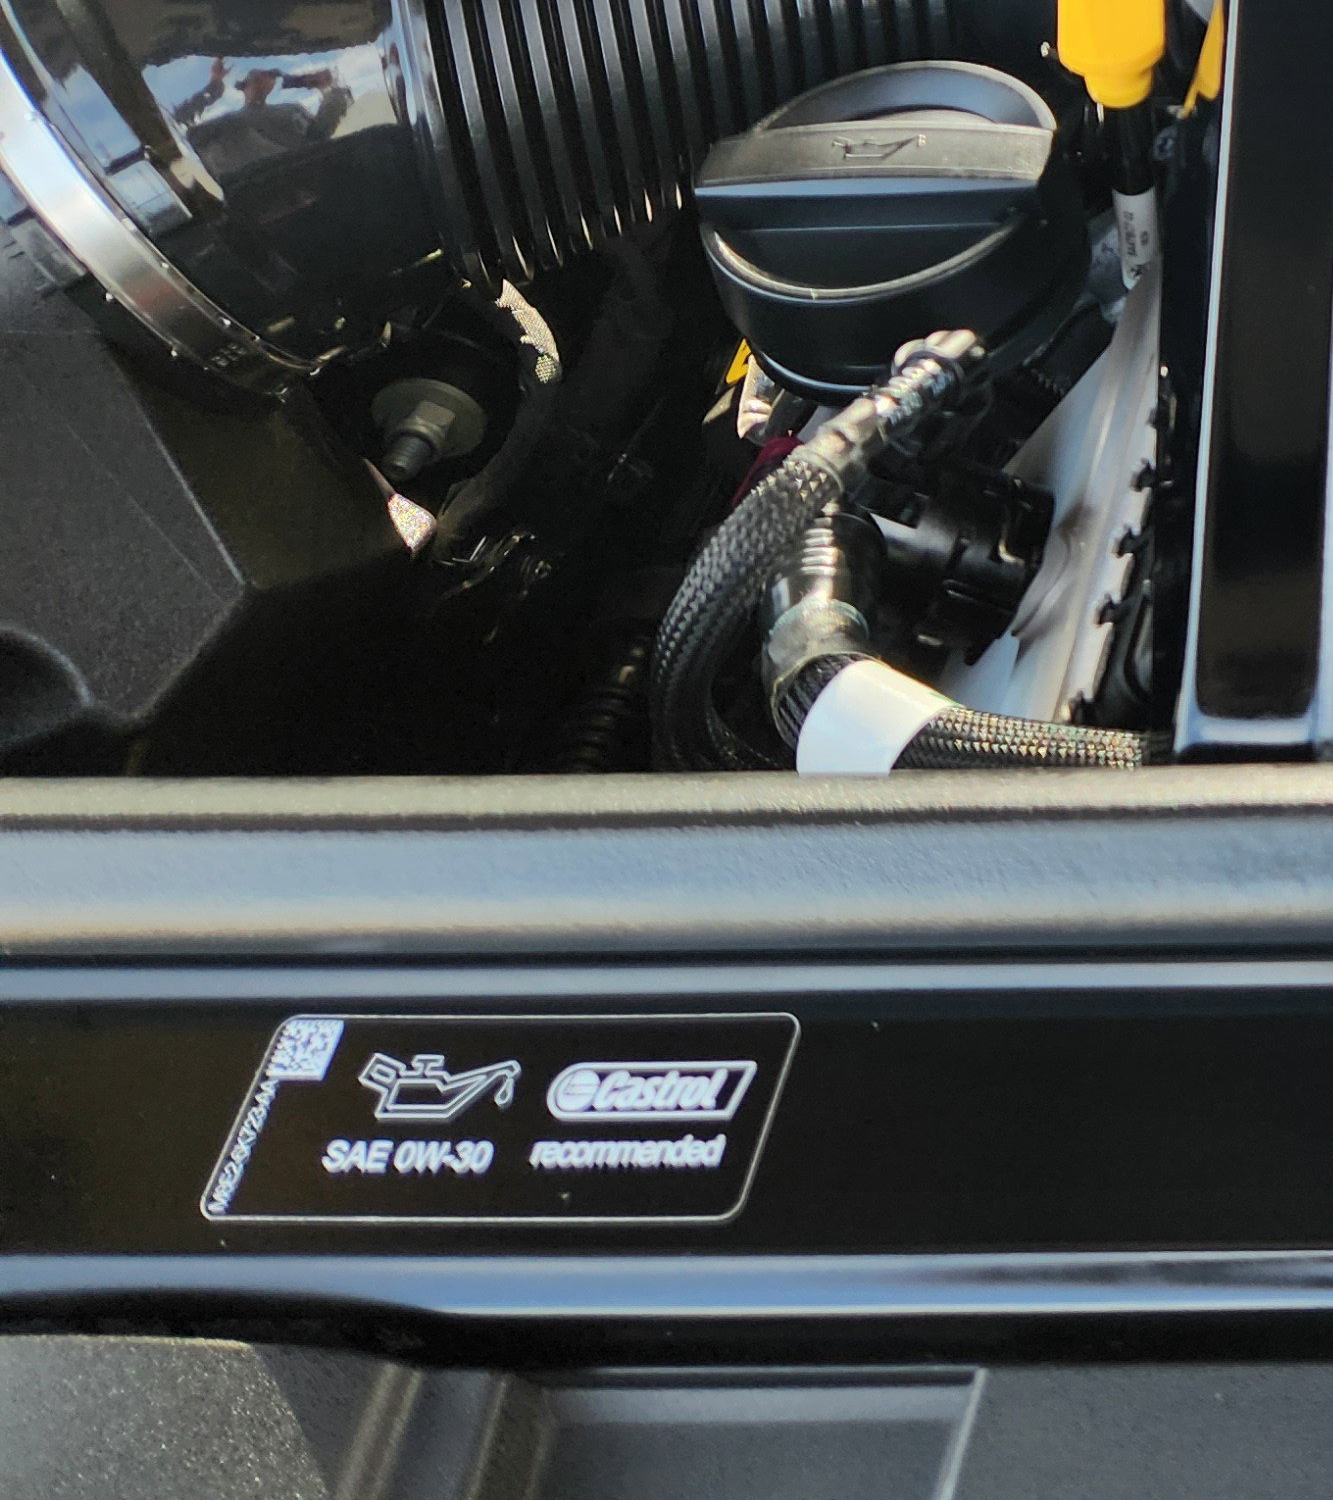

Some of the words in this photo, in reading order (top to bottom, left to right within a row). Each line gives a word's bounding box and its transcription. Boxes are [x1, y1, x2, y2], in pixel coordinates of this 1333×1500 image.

[591, 1068, 729, 1112] Castrol
[321, 1139, 394, 1174] SAE
[393, 1140, 496, 1174] 0W-30
[528, 1133, 728, 1169] recommended
